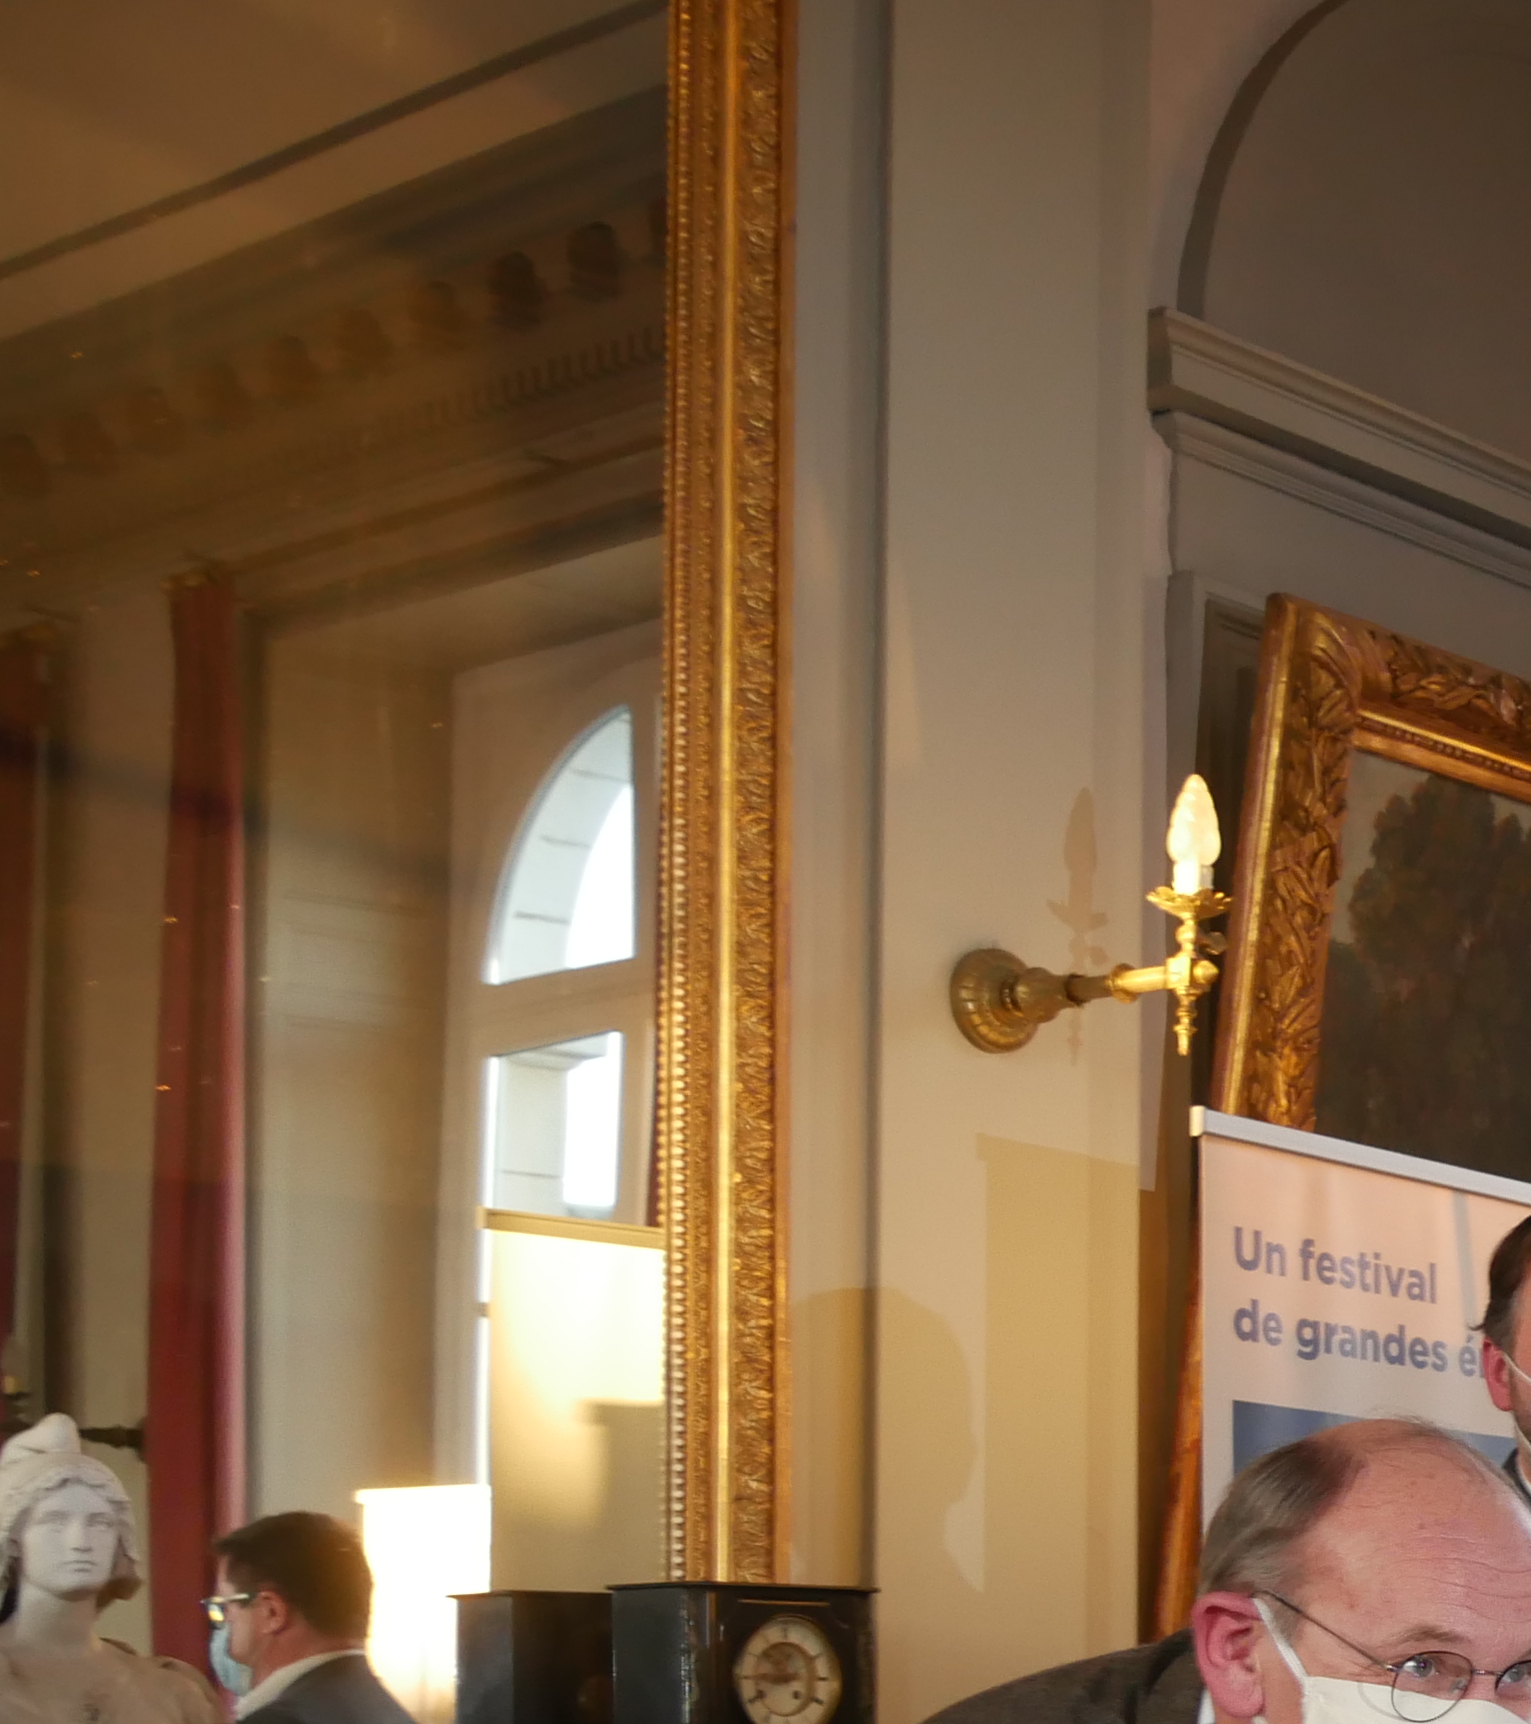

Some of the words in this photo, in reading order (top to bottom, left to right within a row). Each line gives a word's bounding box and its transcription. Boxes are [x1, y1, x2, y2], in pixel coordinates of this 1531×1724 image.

[1234, 1225, 1288, 1277] Un
[1299, 1238, 1438, 1304] festival
[1233, 1298, 1284, 1346] de
[1295, 1317, 1449, 1373] grandes
[1459, 1335, 1484, 1378] é
